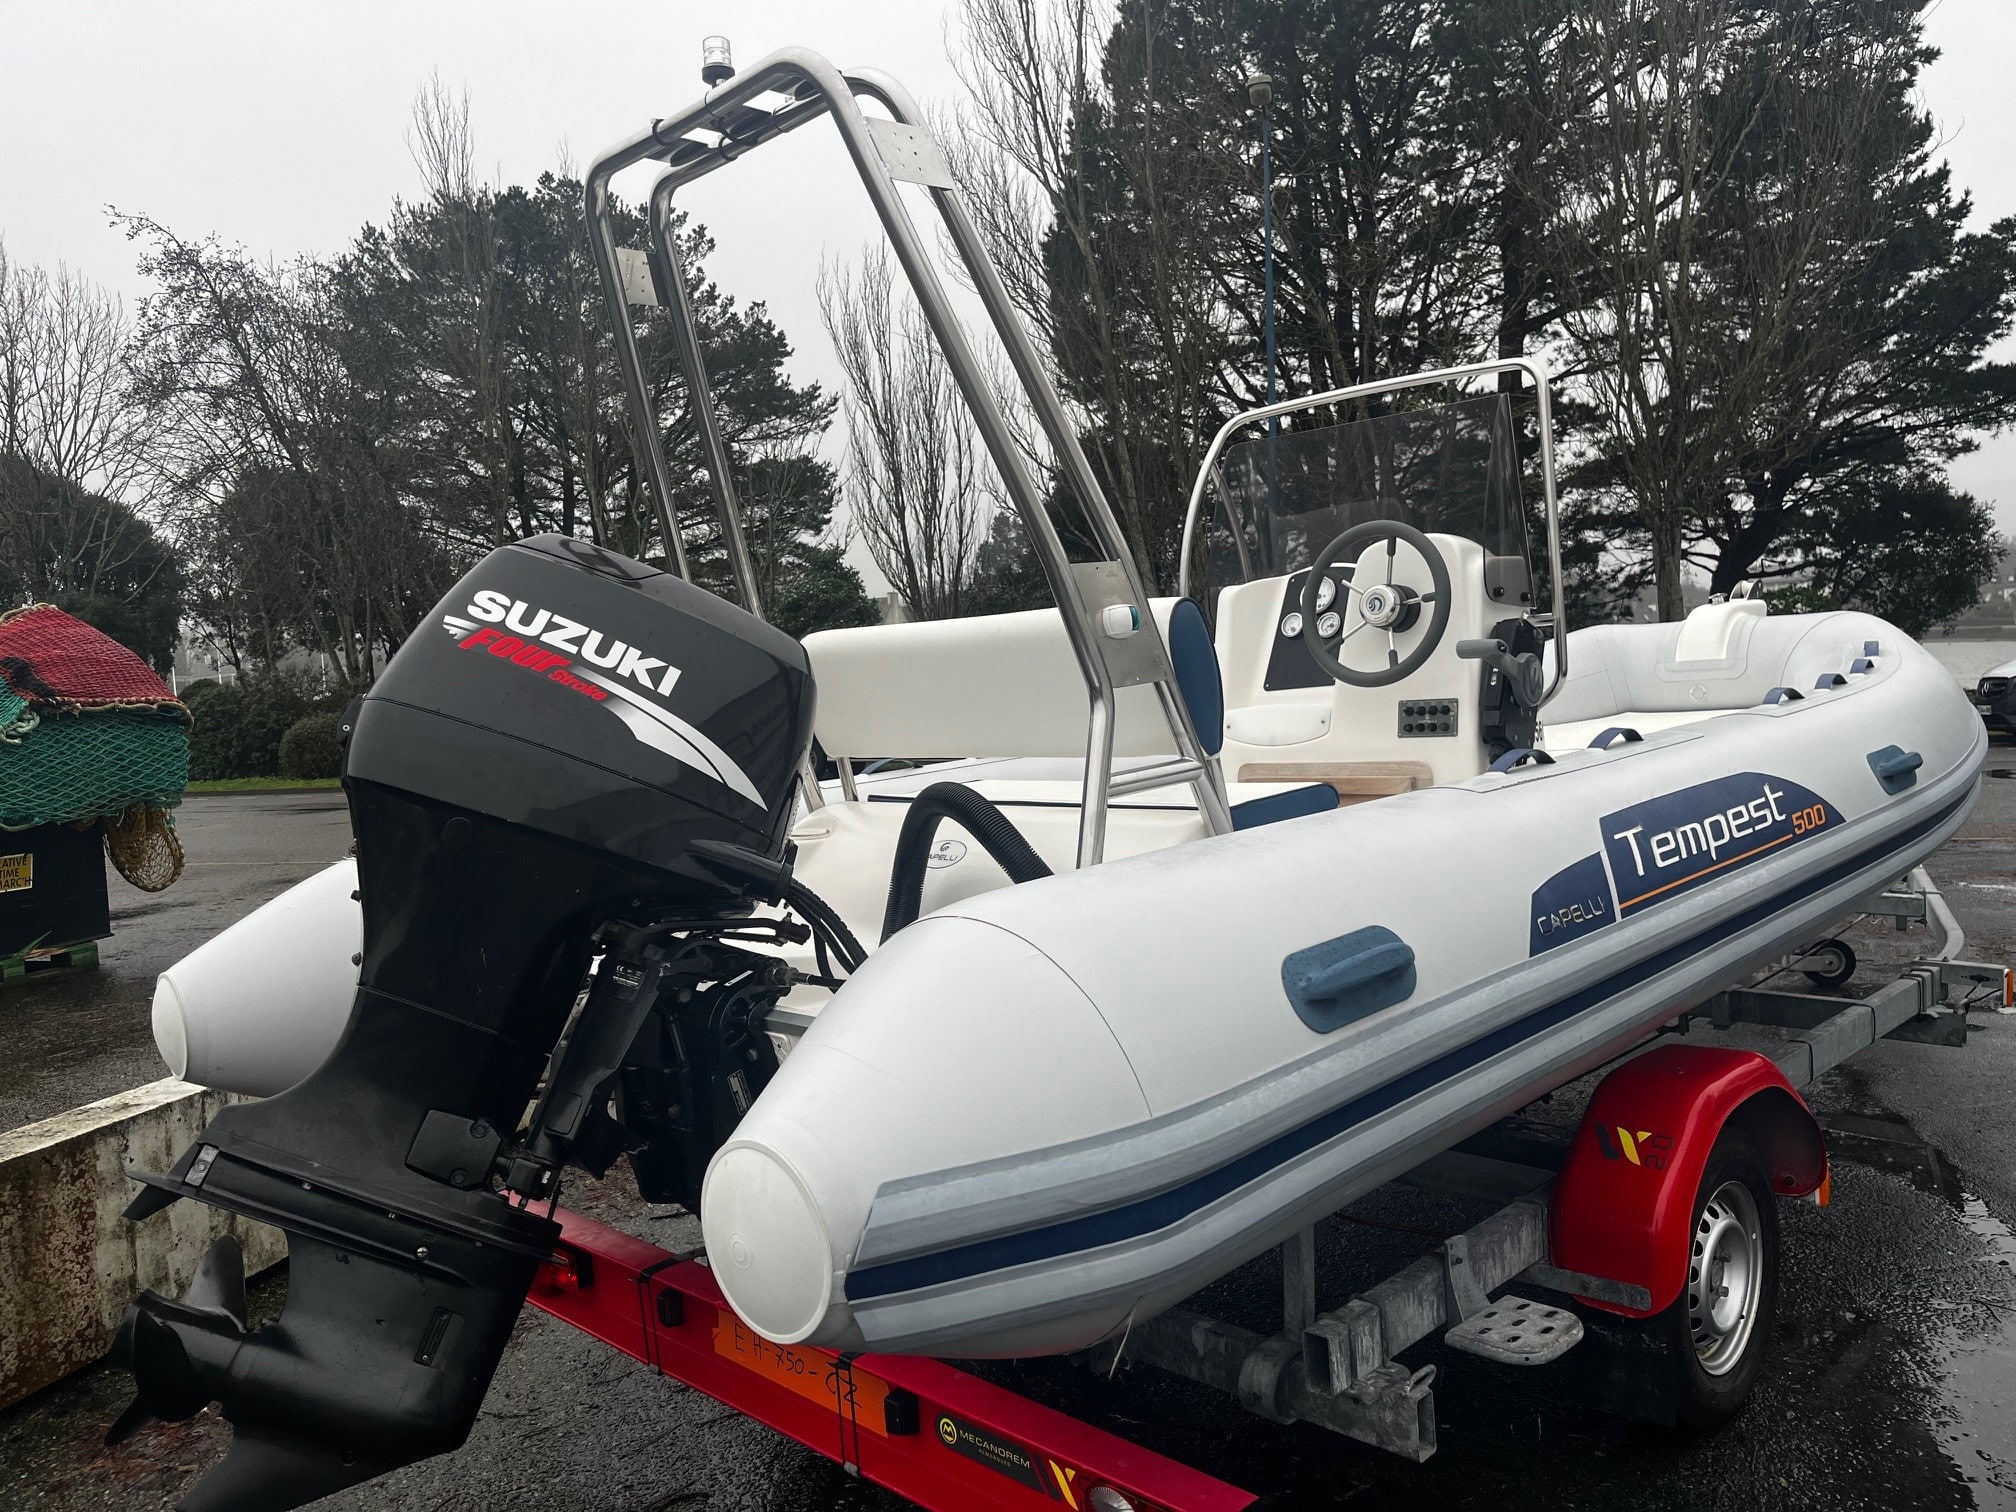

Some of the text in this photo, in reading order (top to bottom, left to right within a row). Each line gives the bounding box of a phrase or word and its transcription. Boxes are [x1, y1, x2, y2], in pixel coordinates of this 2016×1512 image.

[467, 589, 682, 698] SUZUKI
[1613, 783, 1827, 877] Tempest 500
[927, 853, 958, 861] APELLI
[1537, 895, 1606, 936] CAPELLI
[959, 1429, 1030, 1469] MECANOREM
